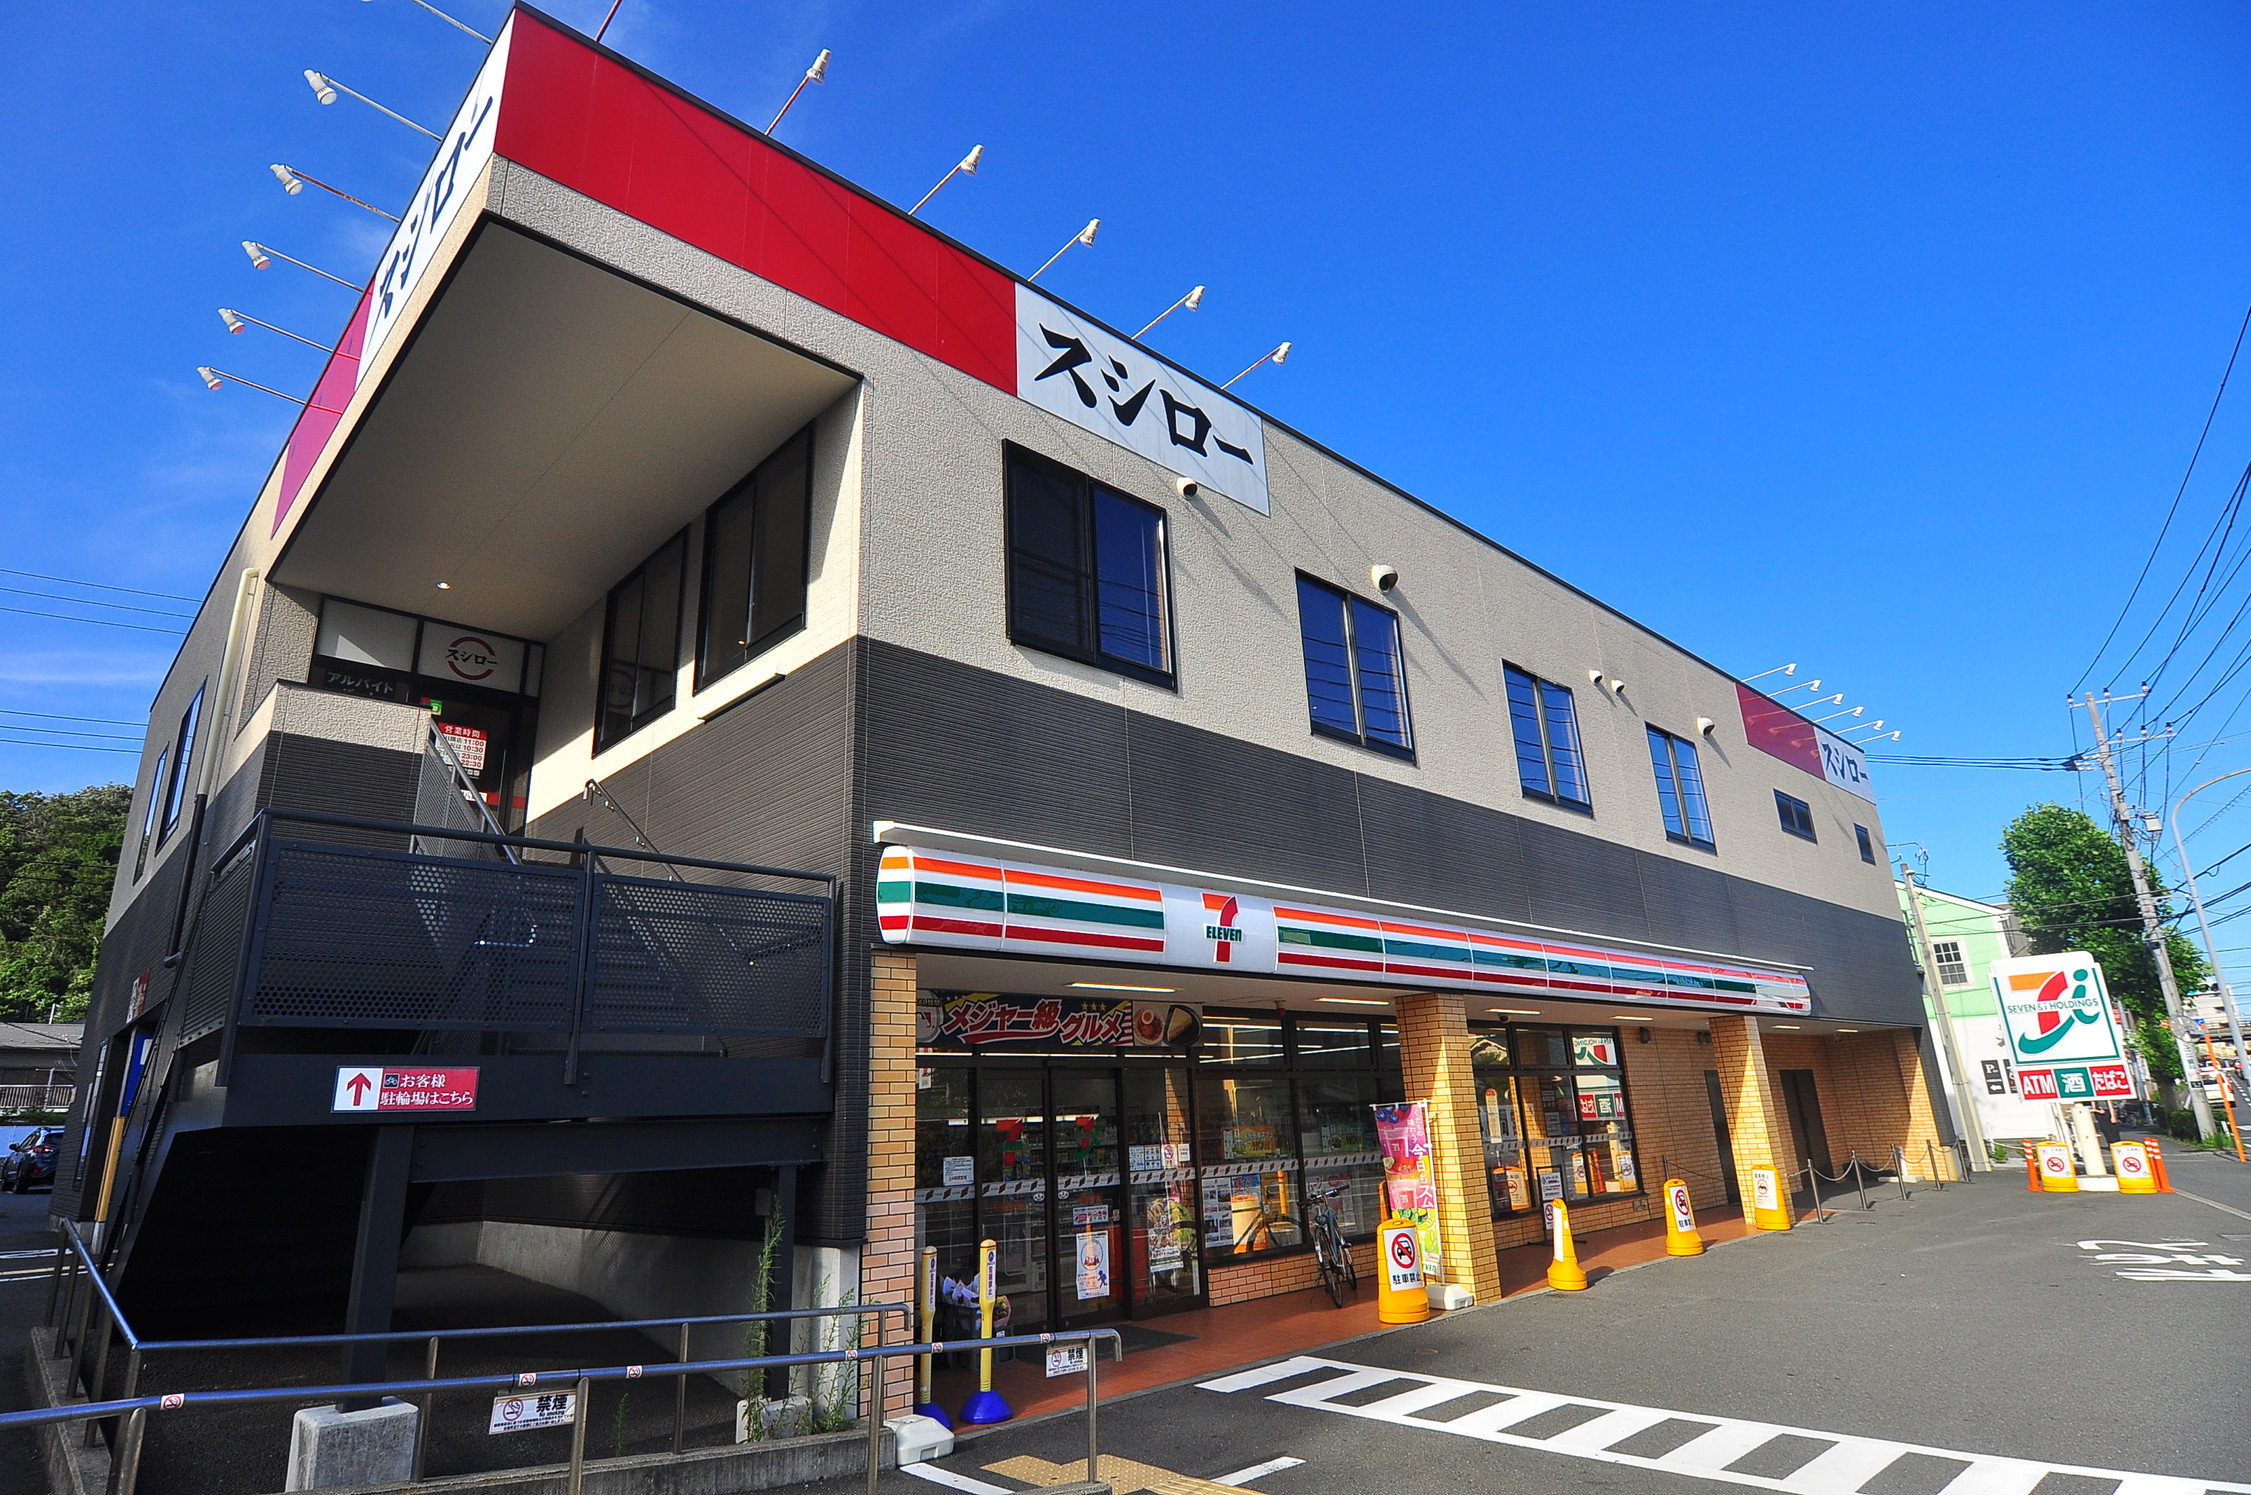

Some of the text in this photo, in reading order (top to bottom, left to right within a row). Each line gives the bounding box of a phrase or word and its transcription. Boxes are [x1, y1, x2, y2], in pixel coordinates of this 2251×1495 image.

[368, 94, 494, 345] スシロー
[1034, 322, 1254, 466] スシロー
[445, 647, 498, 667] スシロー
[326, 671, 394, 694] アルバイト
[463, 738, 485, 747] 11:00
[463, 744, 484, 753] 10:30
[461, 753, 483, 761] 23:00
[461, 759, 482, 768] 22:30
[1821, 743, 1869, 784] スシロー
[2049, 998, 2099, 1010] HOLDINGS
[400, 1073, 446, 1088] お客様
[2023, 1074, 2056, 1095] ATM
[2061, 1072, 2085, 1094] 酒
[2092, 1071, 2129, 1091] たばこ
[380, 1091, 473, 1106] 駐輪場はこちら
[1392, 1272, 1422, 1286] 駐車禁止
[536, 1394, 568, 1413] 禁煙
